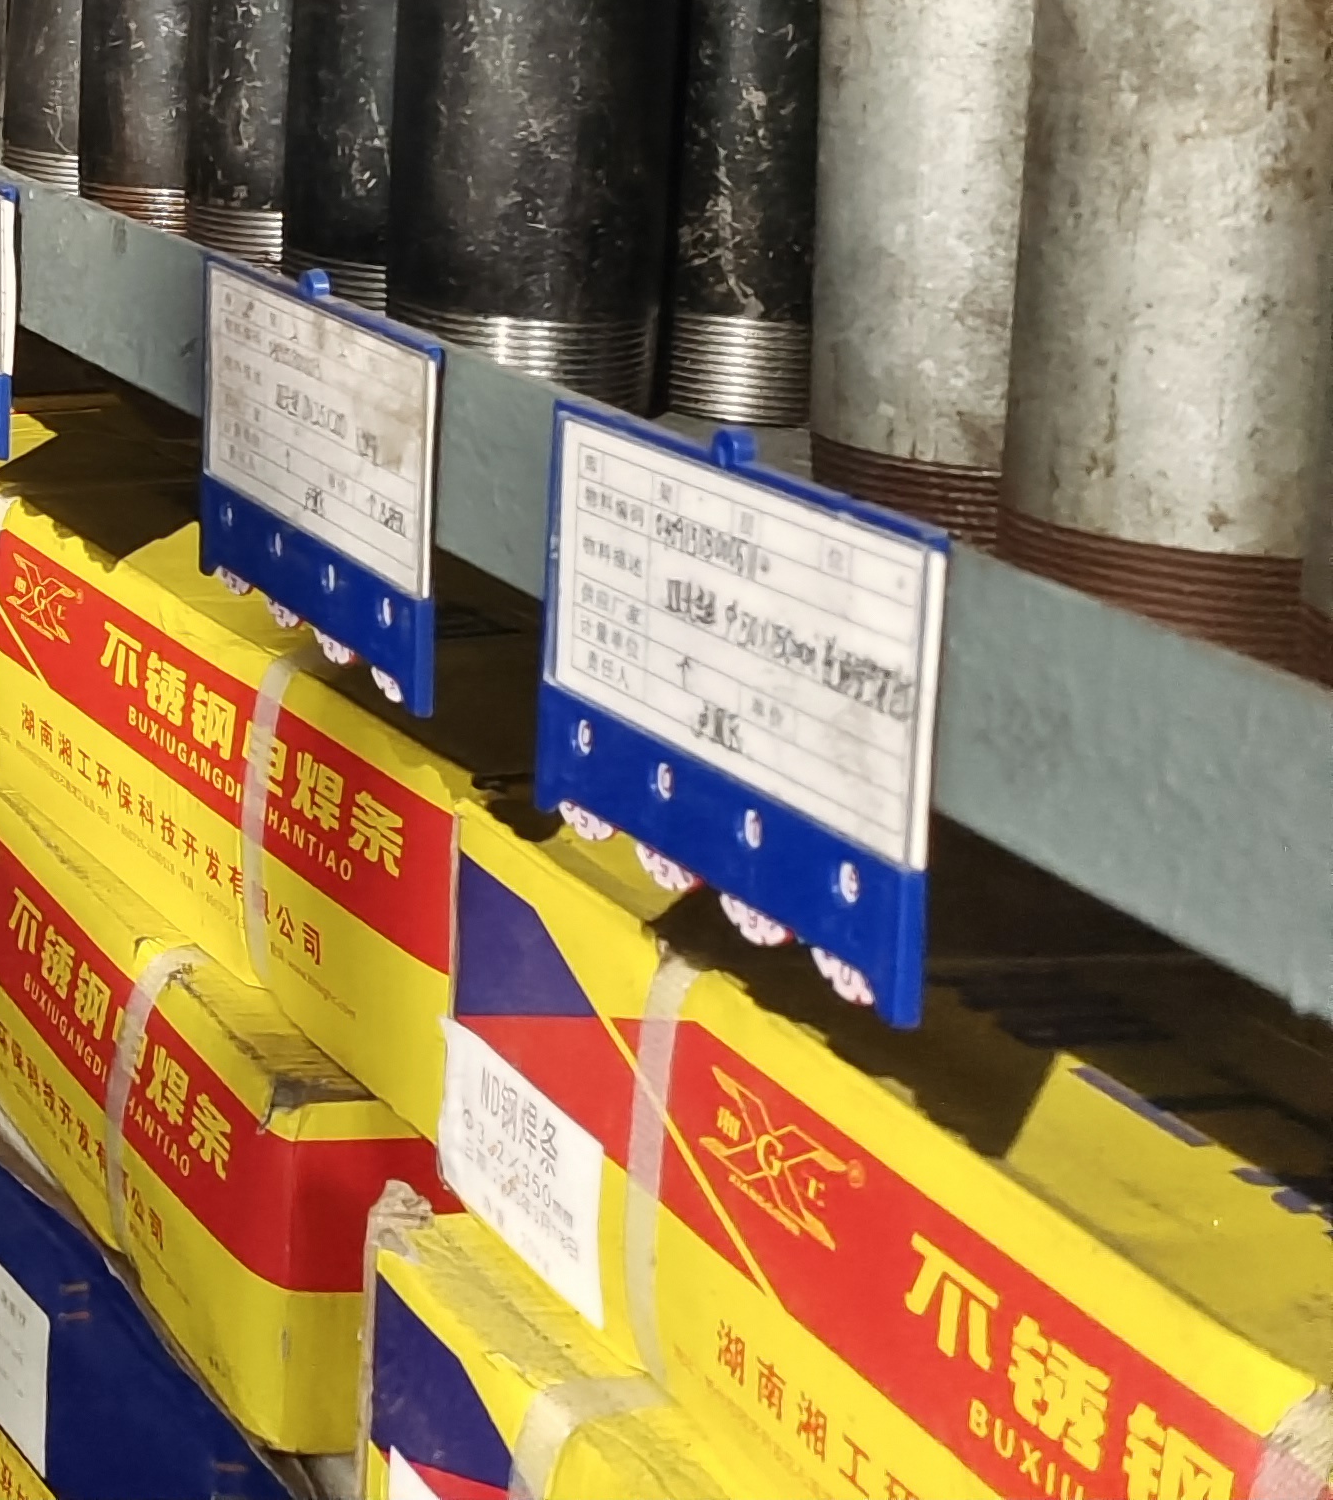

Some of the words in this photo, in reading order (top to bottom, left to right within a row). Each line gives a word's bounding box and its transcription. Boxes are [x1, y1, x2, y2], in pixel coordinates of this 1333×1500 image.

[20, 702, 323, 967] 湖南湘工环保科技开发有公司
[99, 620, 405, 879] 不锈钢电焊条
[127, 704, 353, 882] BUXIUGANGDIHANTIAO
[23, 971, 191, 1177] BUXIUGANGDIANTIAO
[904, 1231, 1236, 1500] 不锈钢
